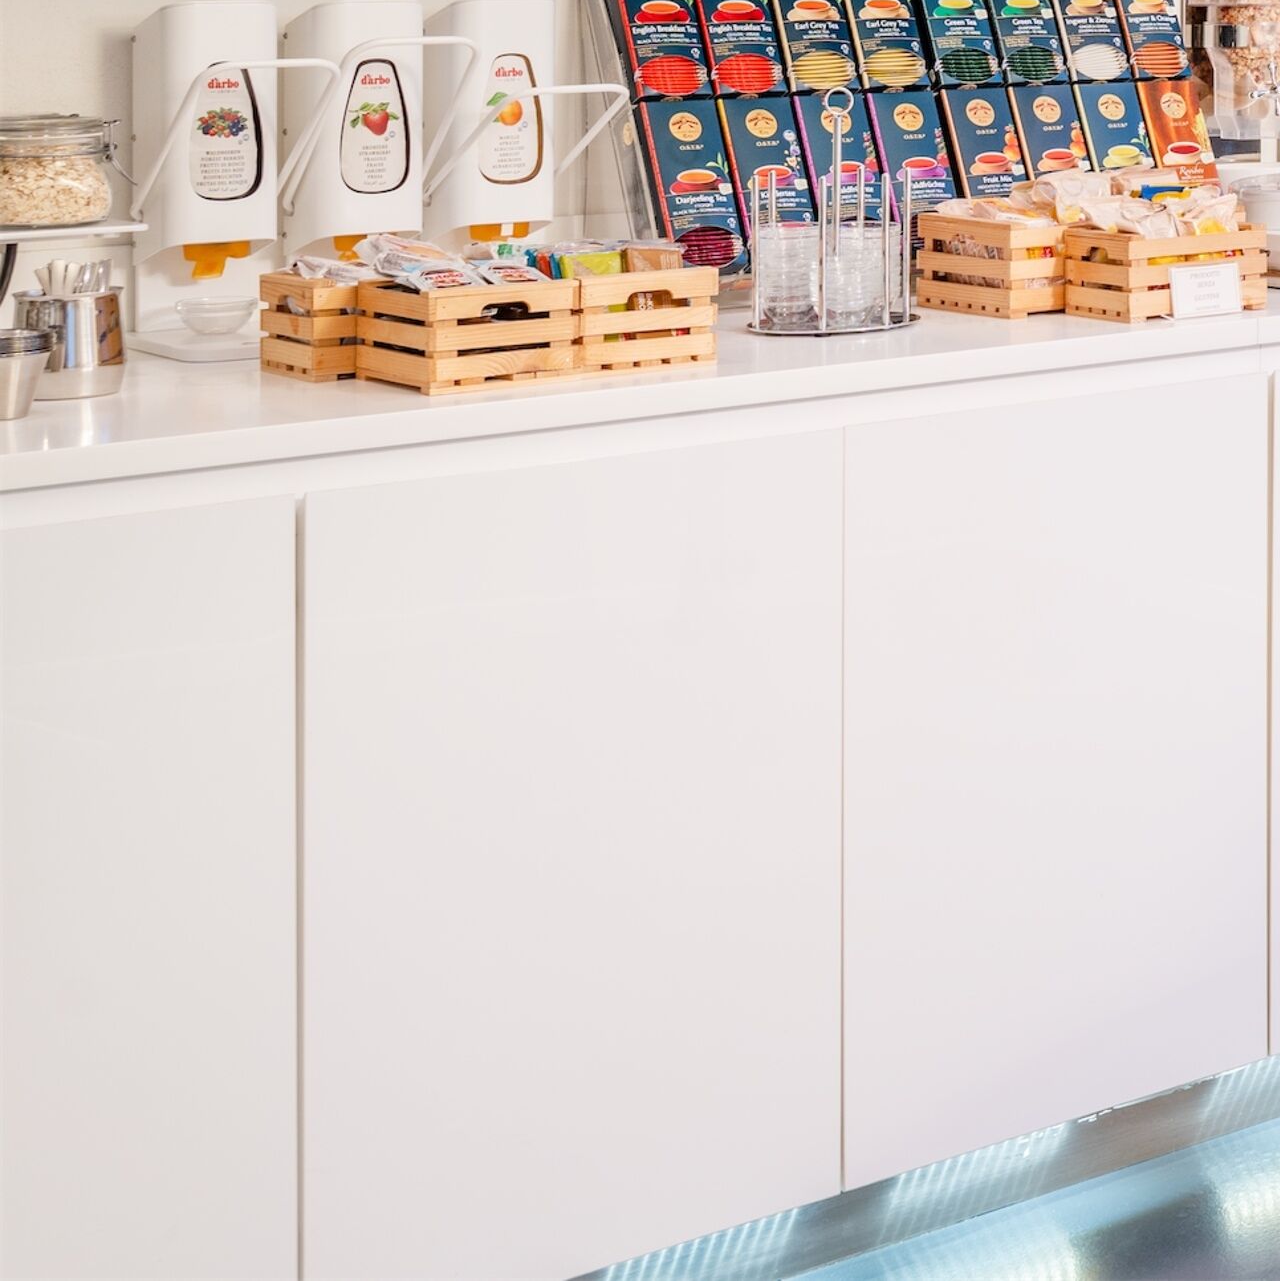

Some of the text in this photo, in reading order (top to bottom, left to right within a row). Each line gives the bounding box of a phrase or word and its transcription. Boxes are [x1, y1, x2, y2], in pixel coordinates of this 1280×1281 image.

[794, 21, 840, 32] Earl Grey Tea
[866, 19, 910, 30] Earl Grey Tea
[944, 18, 977, 26] Green Tea
[1012, 18, 1030, 26] Green
[632, 24, 656, 36] English
[656, 24, 685, 33] Breakfast
[686, 24, 697, 33] Tea
[708, 24, 772, 35] English Breakfast Tea
[983, 175, 1013, 183] Fruit Mix
[675, 194, 727, 205] Darjeeling Tea
